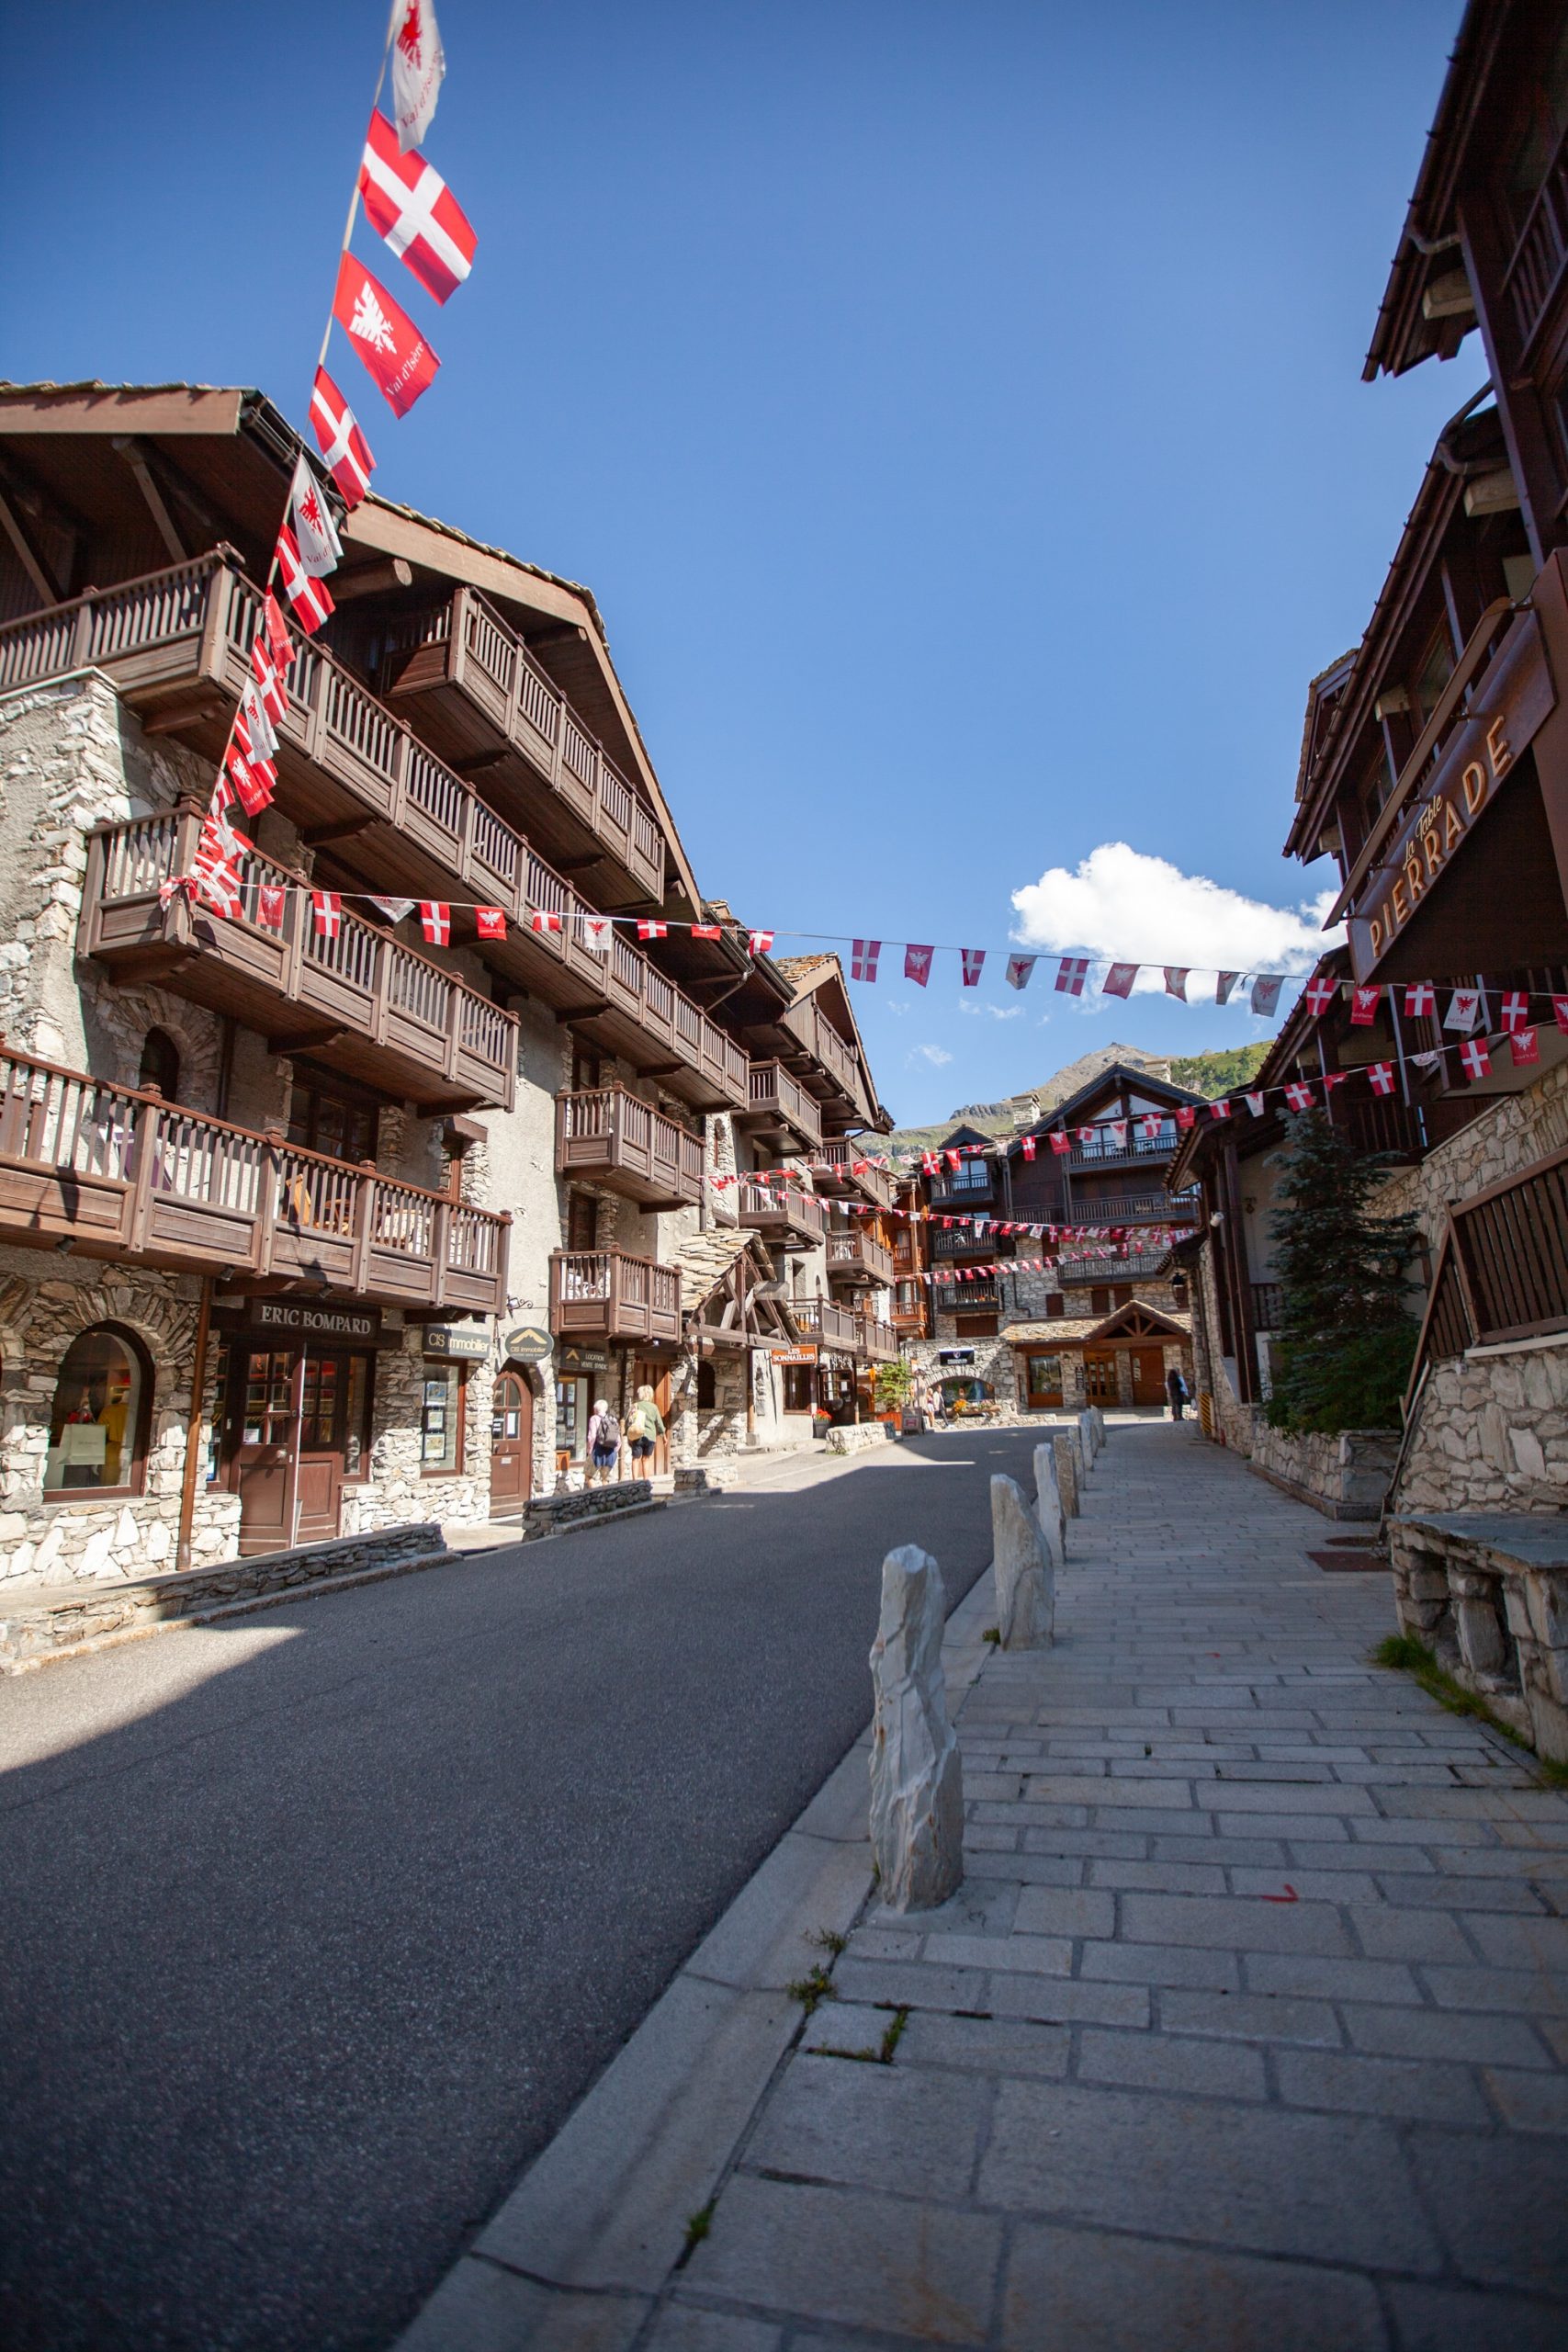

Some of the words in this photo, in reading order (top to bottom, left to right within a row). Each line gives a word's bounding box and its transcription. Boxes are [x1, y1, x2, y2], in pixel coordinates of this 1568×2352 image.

[386, 376, 403, 396] Val
[401, 341, 424, 380] d'Isère
[1415, 794, 1443, 842] Table
[1370, 715, 1513, 958] PIERRADE
[261, 1306, 299, 1326] ERIC
[302, 1311, 371, 1334] BOMPARD
[428, 1333, 446, 1348] CIS
[788, 1347, 801, 1355] LES
[585, 1352, 604, 1362] LOCATION
[773, 1352, 816, 1363] SONNAILLES
